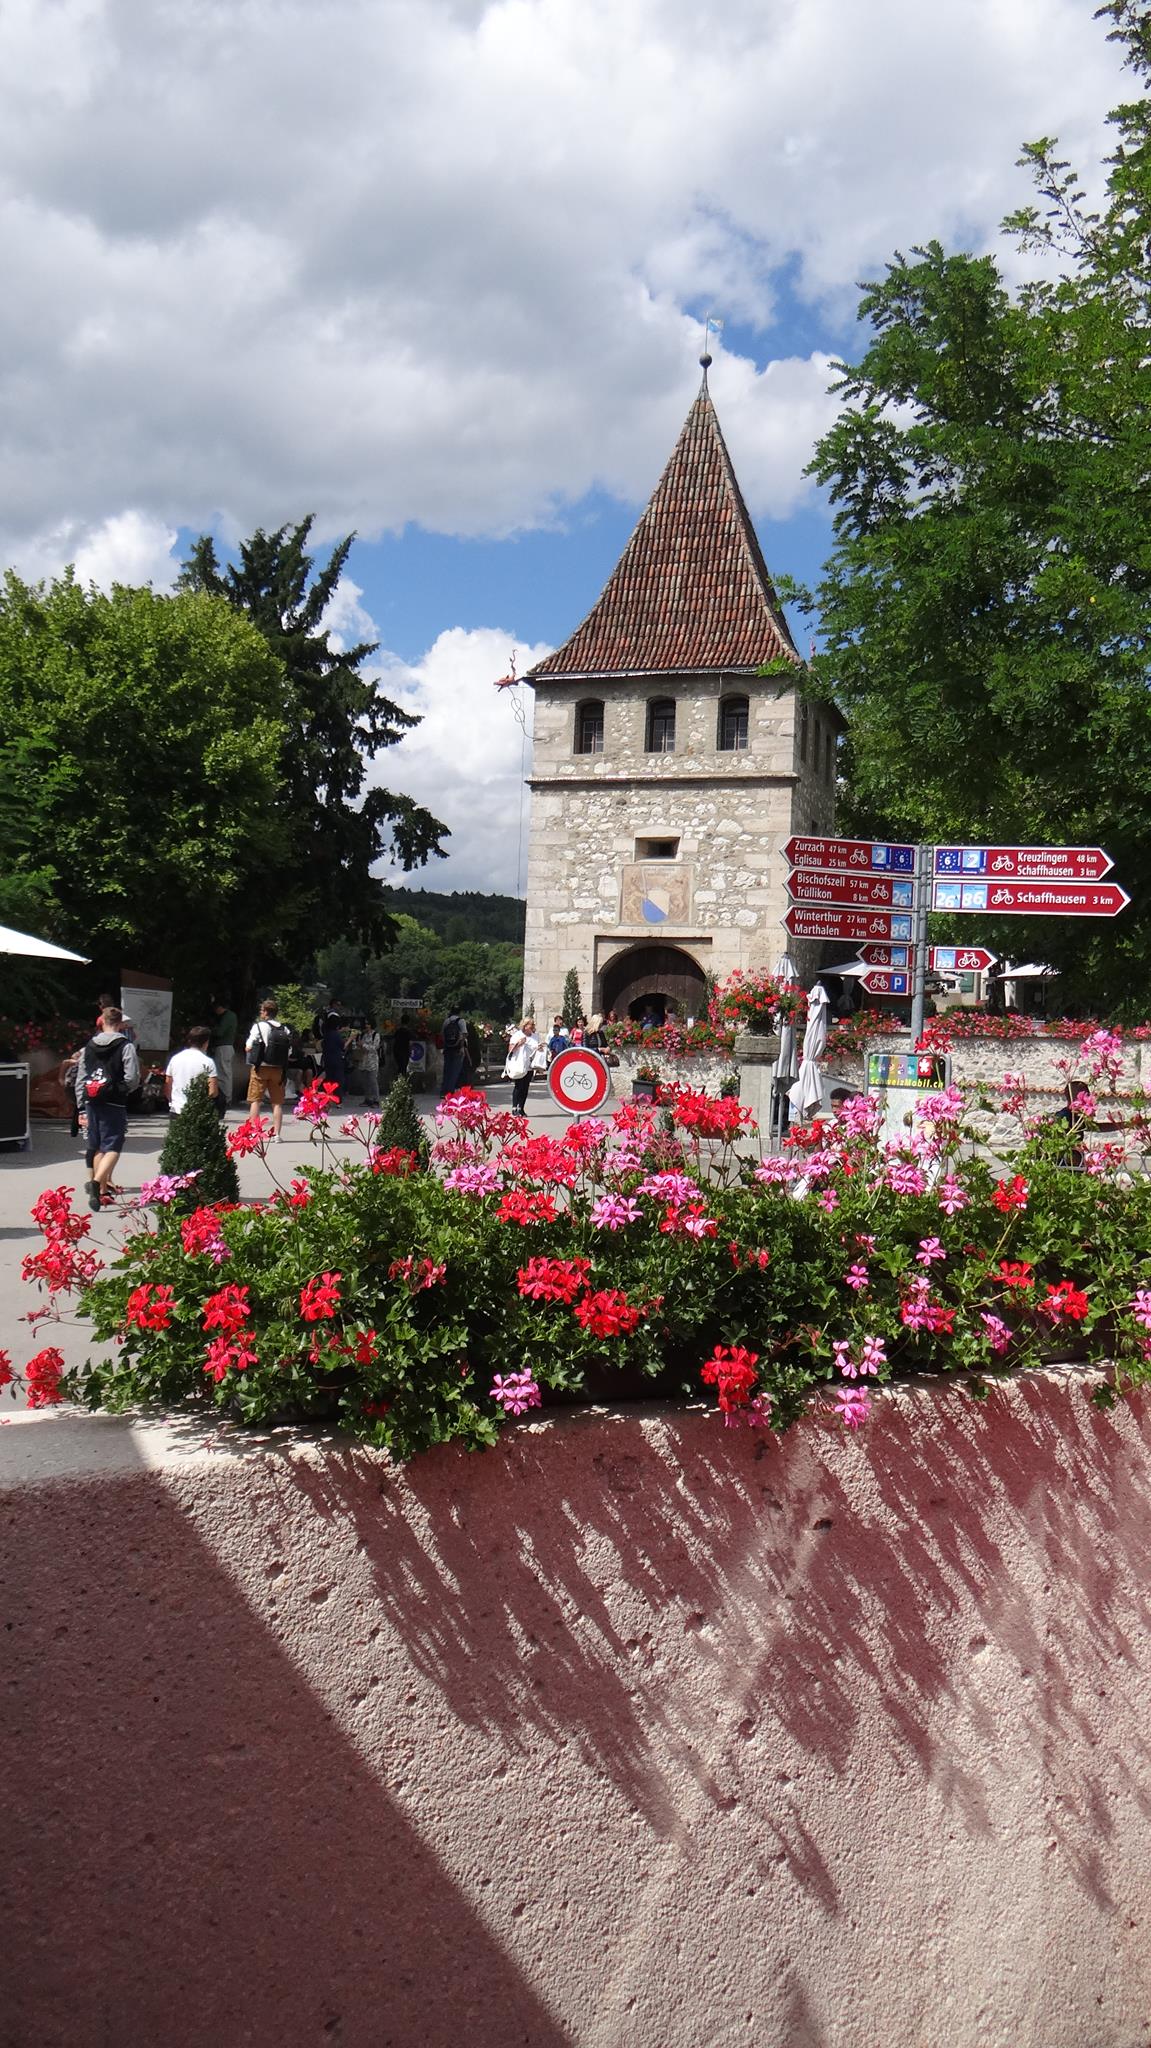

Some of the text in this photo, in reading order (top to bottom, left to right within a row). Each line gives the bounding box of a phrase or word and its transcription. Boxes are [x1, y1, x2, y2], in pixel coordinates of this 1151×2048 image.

[794, 841, 847, 854] Zurzach 47 km
[794, 854, 847, 867] Eglisau 25 km
[874, 849, 886, 864] 2
[899, 854, 905, 863] 6
[944, 856, 951, 865] 6
[966, 854, 978, 868] 2
[1017, 852, 1097, 865] Kreuzlingen 48 km
[1017, 865, 1096, 876] Schaffhausen 3 km
[797, 874, 869, 889] Bischofszell 57 km
[797, 886, 832, 899] Trüllikon
[859, 894, 869, 903] km
[893, 891, 907, 907] 26
[937, 893, 955, 908] 26
[961, 892, 984, 906] 86
[1017, 892, 1113, 905] Schaffhausen 3 km
[794, 910, 867, 924] Winterthur 27 km
[794, 924, 867, 937] Marthalen 7 km
[891, 923, 908, 938] 86
[894, 977, 902, 990] P
